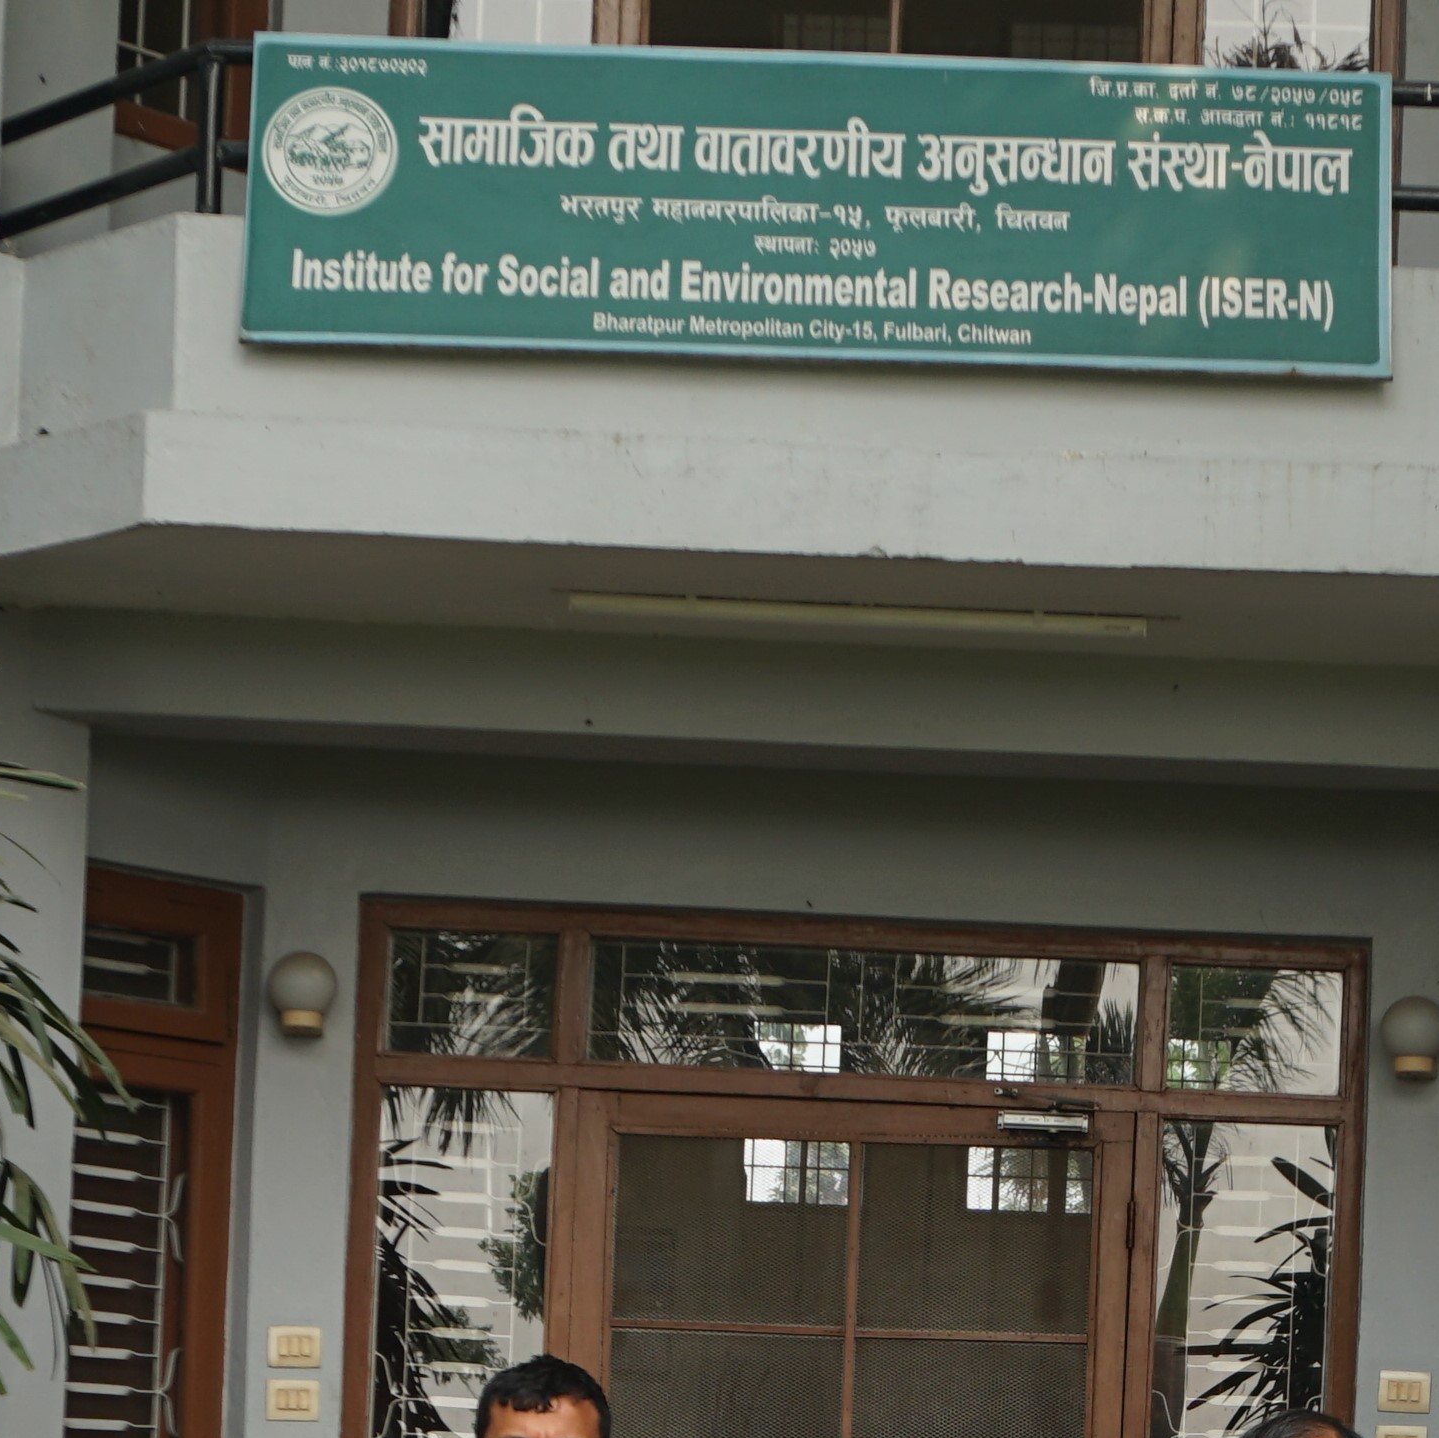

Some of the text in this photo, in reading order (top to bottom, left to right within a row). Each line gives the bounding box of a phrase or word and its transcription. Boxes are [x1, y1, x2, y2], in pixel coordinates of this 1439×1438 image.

[418, 103, 598, 169] सामाजिक
[608, 121, 684, 174] तथा
[695, 116, 906, 179] वातावरणीय
[917, 133, 1117, 197] अनुसन्धान
[1127, 129, 1354, 196] संस्था-नेपाल
[560, 195, 644, 225] भरतपुर
[994, 203, 1072, 233] चितवन
[829, 237, 877, 260] २०५७
[291, 247, 1335, 333] Institute for Social and Environmental Research-Nepal (ISER-N)
[593, 311, 1032, 346] Bharatpur Metropolitan City-15, Fulbari, Chitwan
